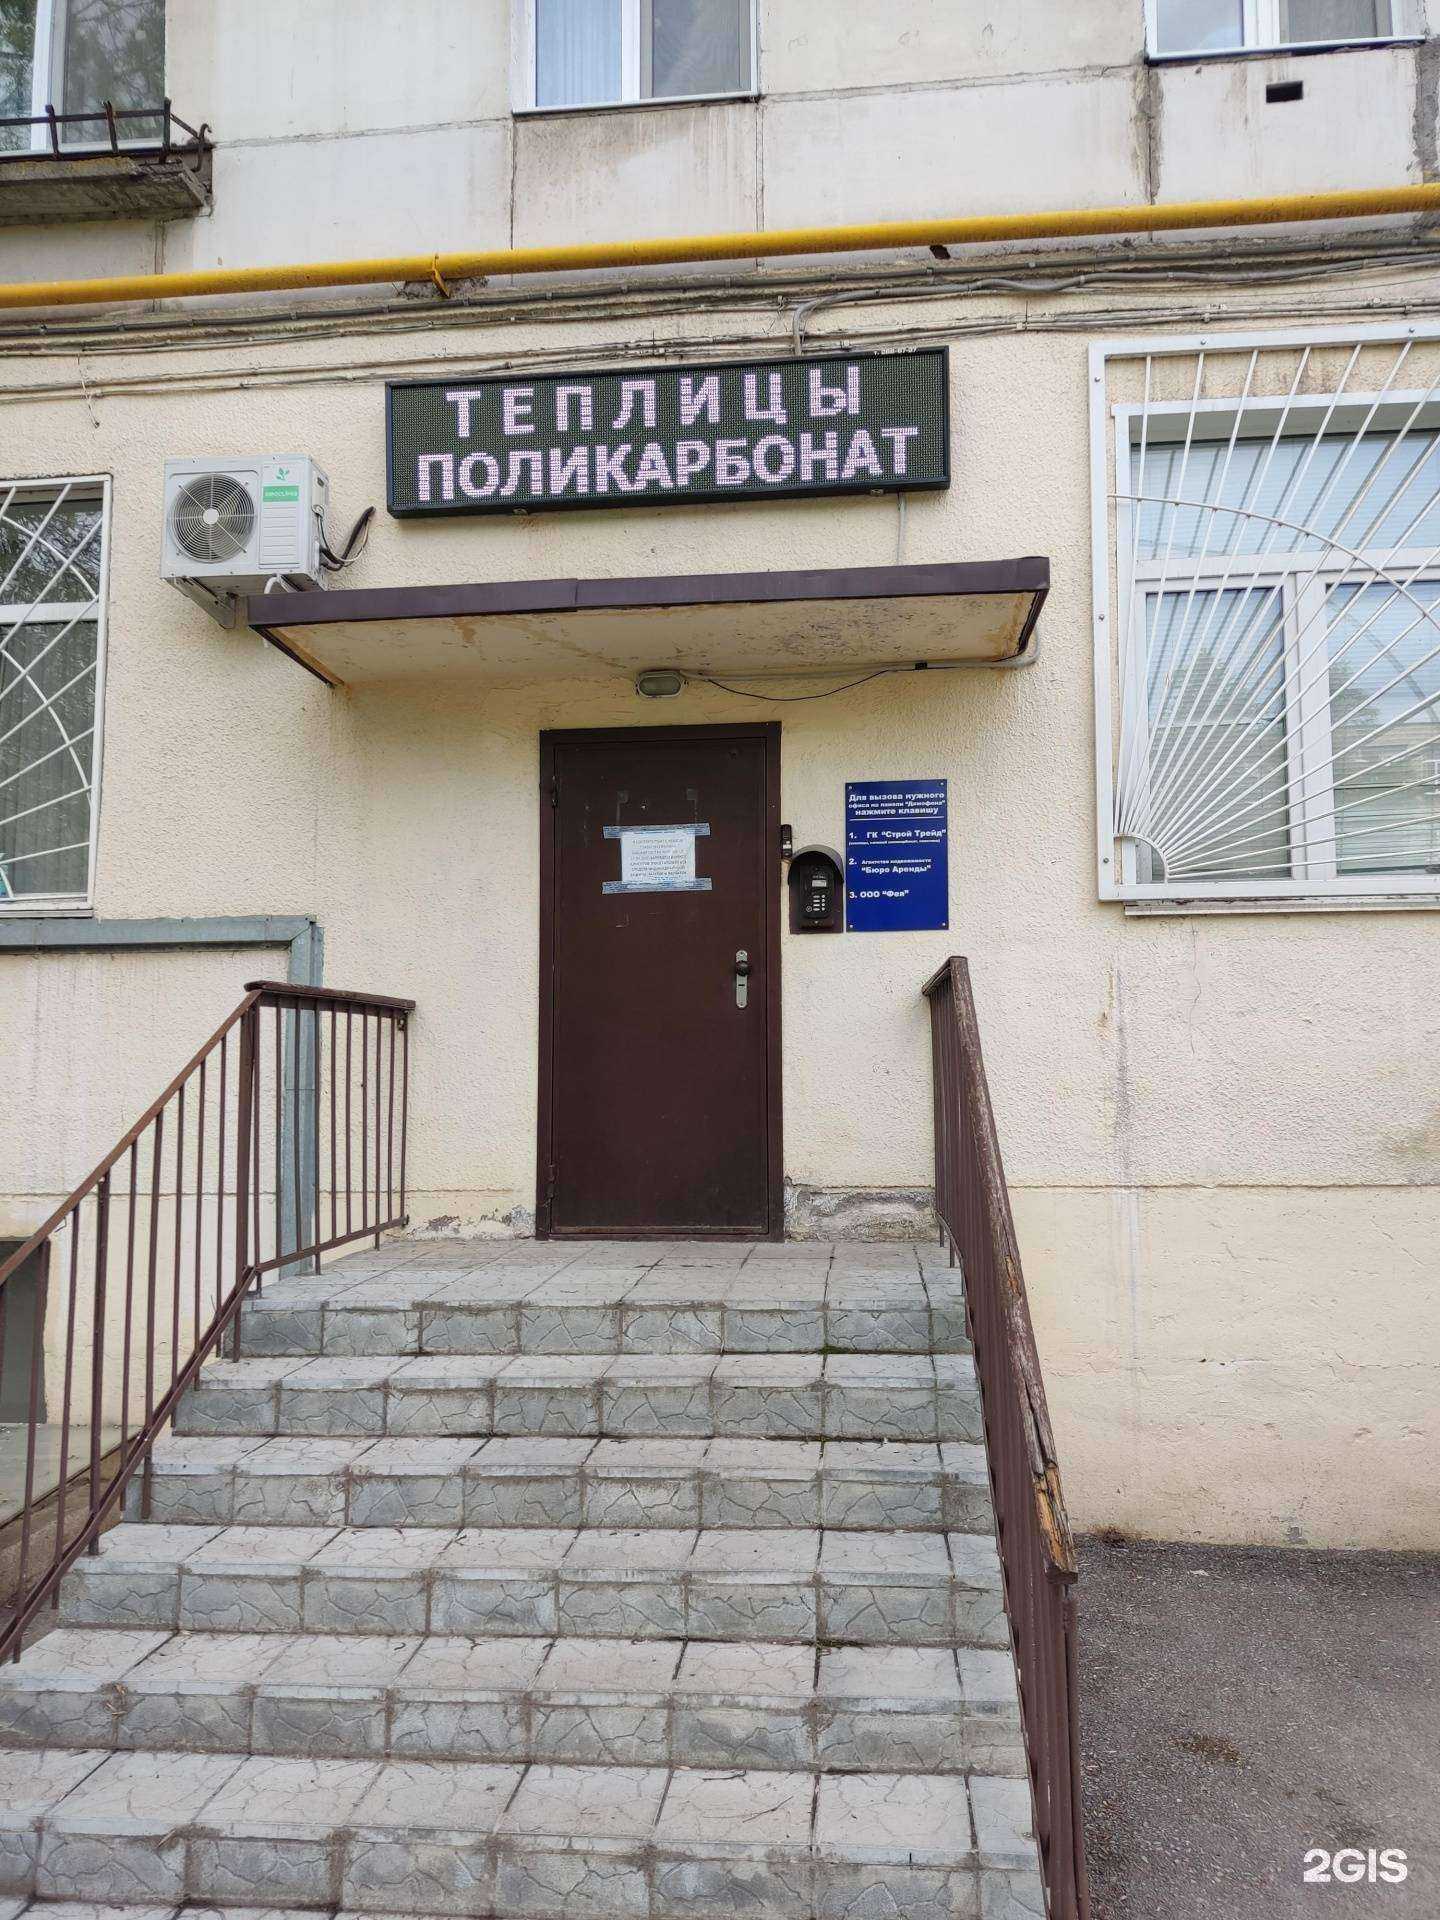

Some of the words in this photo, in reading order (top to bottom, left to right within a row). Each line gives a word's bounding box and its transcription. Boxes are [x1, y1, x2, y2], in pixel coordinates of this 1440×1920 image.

[445, 365, 861, 438] ТЕПЛИЦЫ
[416, 425, 919, 502] ПОЛИКАРБОНАТ
[848, 794, 867, 802] Для
[869, 793, 903, 801] вызова
[905, 792, 945, 801] нужного
[855, 808, 896, 816] нажмите
[898, 807, 939, 815] клавишу
[866, 831, 879, 839] ГК
[881, 830, 912, 839] "Строй
[914, 828, 947, 839] Трейд"
[861, 866, 890, 875] "Бюро
[892, 864, 932, 873] Аренды"
[849, 891, 858, 899] 3.
[860, 890, 881, 898] ООО
